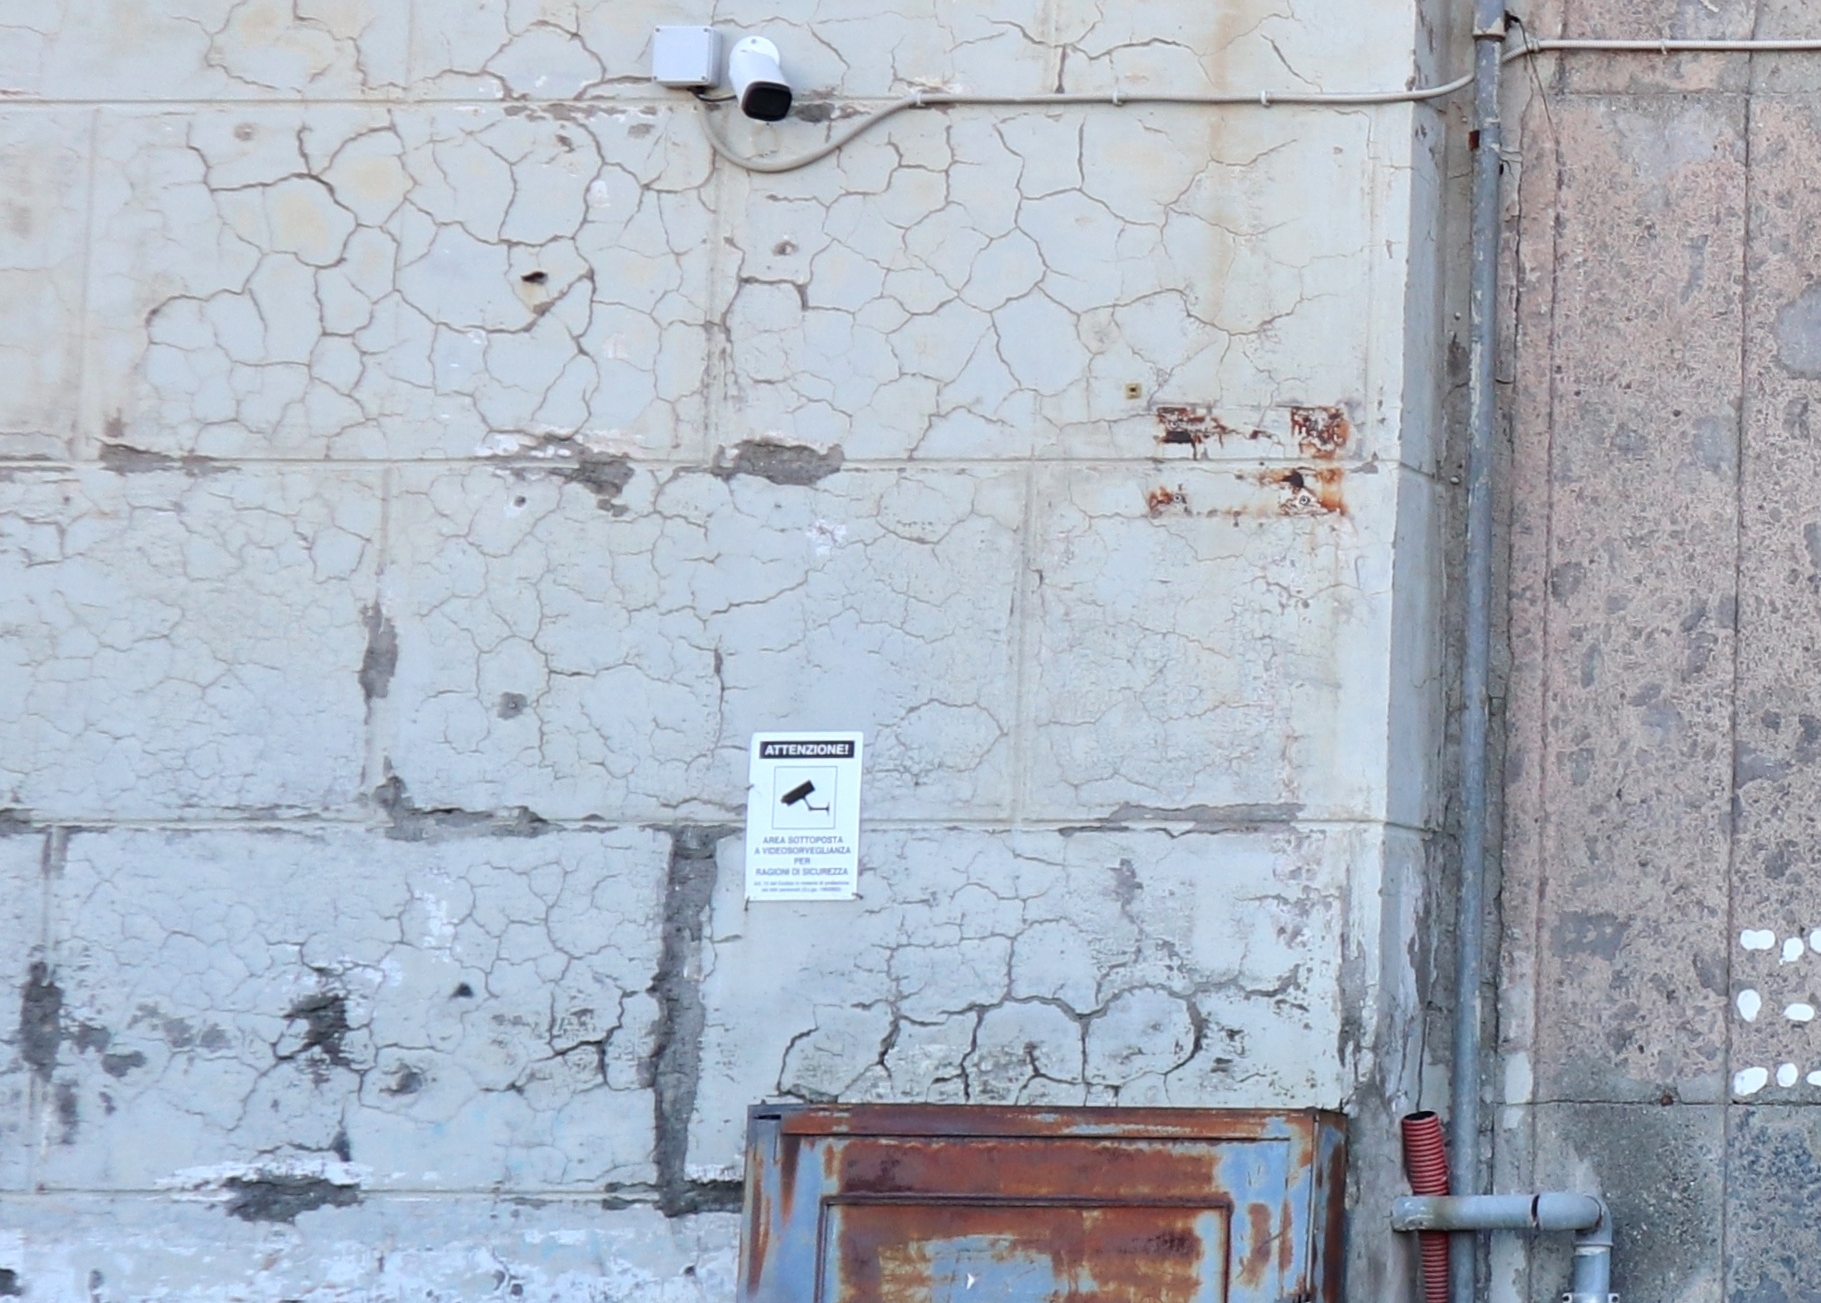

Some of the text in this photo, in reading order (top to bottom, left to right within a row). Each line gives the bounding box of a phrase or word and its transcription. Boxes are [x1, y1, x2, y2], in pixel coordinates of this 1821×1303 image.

[764, 744, 849, 756] ATTENZIONE!
[762, 836, 843, 844] AREA SOTTOPOSTA
[762, 846, 851, 855] VIDEOSORVEGLIANZA
[793, 857, 811, 865] PER
[755, 868, 790, 876] RAGIONI
[802, 867, 848, 875] SICUREZZA
